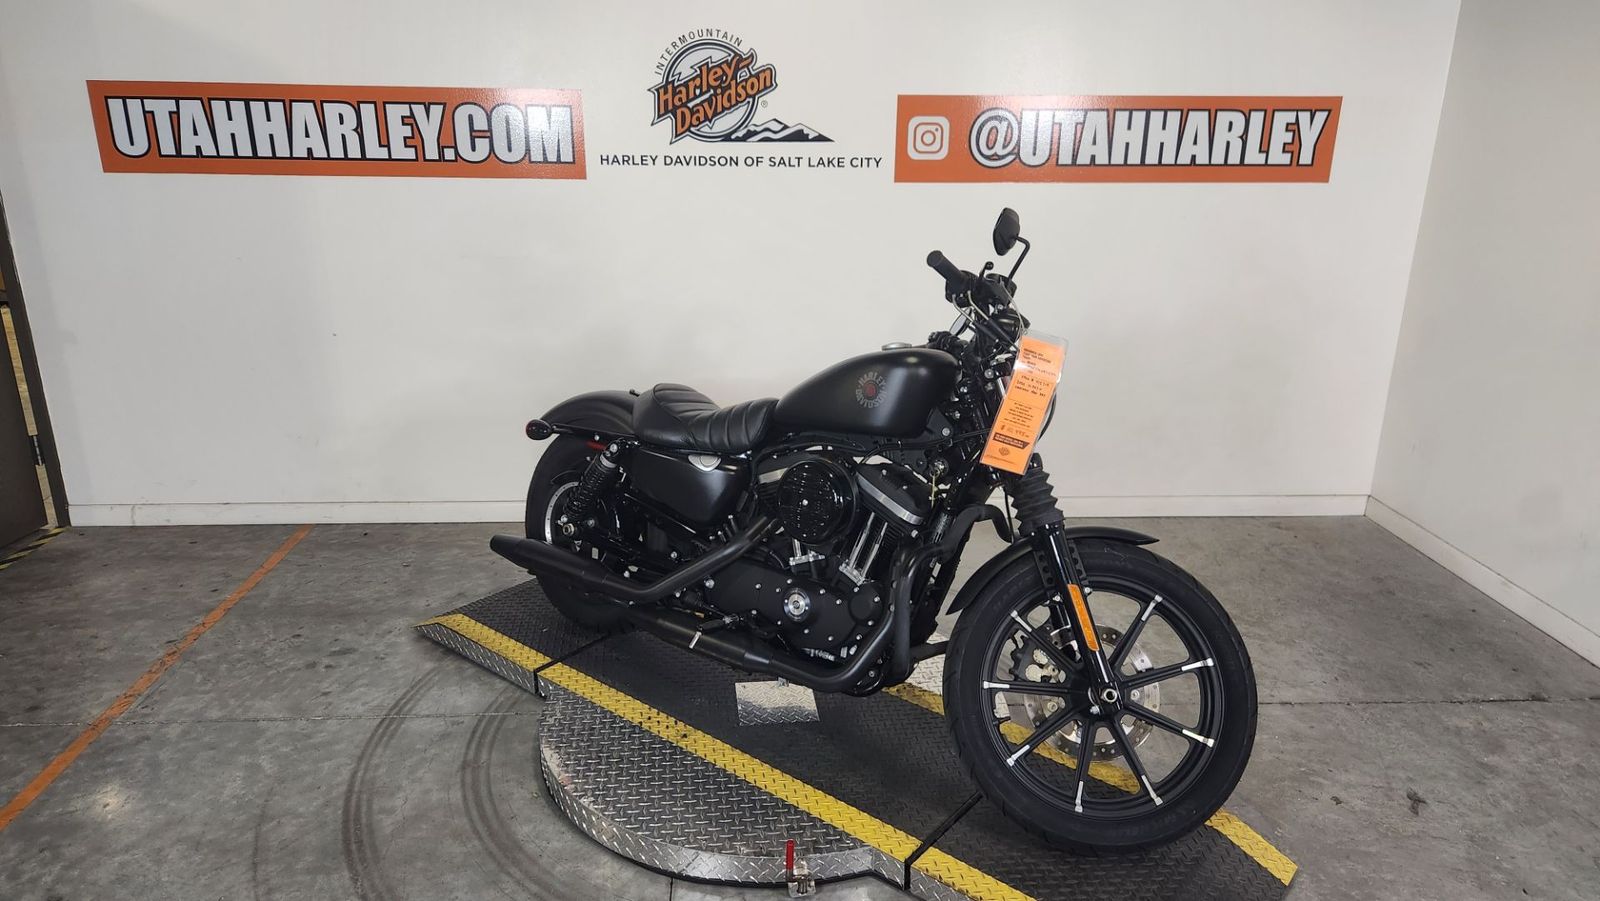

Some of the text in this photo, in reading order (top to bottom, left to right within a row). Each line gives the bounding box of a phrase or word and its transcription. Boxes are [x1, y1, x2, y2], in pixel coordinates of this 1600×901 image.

[655, 28, 743, 76] INTERMOUNTAIN
[105, 96, 575, 164] UTAHHARLEY.COM
[673, 66, 774, 136] Davidson
[600, 154, 882, 168] HARLEY DAVIDSON OF SALT LAKE CITY
[969, 108, 1332, 169] @UTAHHARLEY
